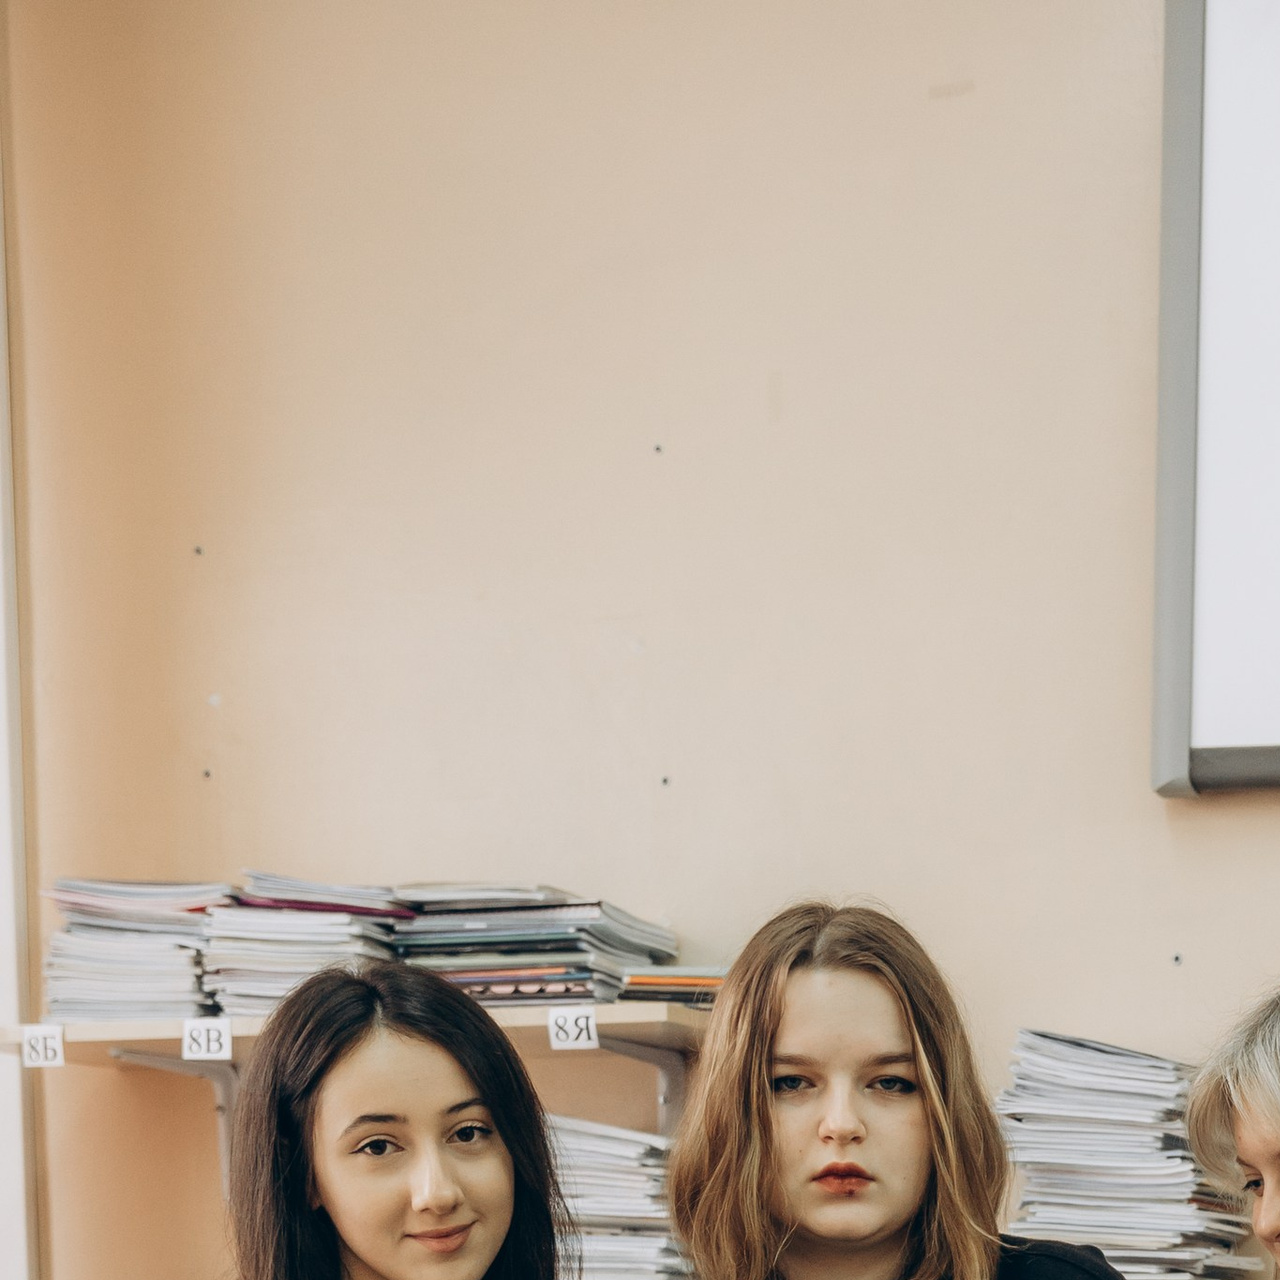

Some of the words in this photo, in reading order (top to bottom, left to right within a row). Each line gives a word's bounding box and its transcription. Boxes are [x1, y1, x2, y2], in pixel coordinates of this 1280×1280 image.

[188, 1028, 224, 1055] 8В
[554, 1015, 592, 1042] 8Я
[27, 1035, 58, 1063] 8Б
